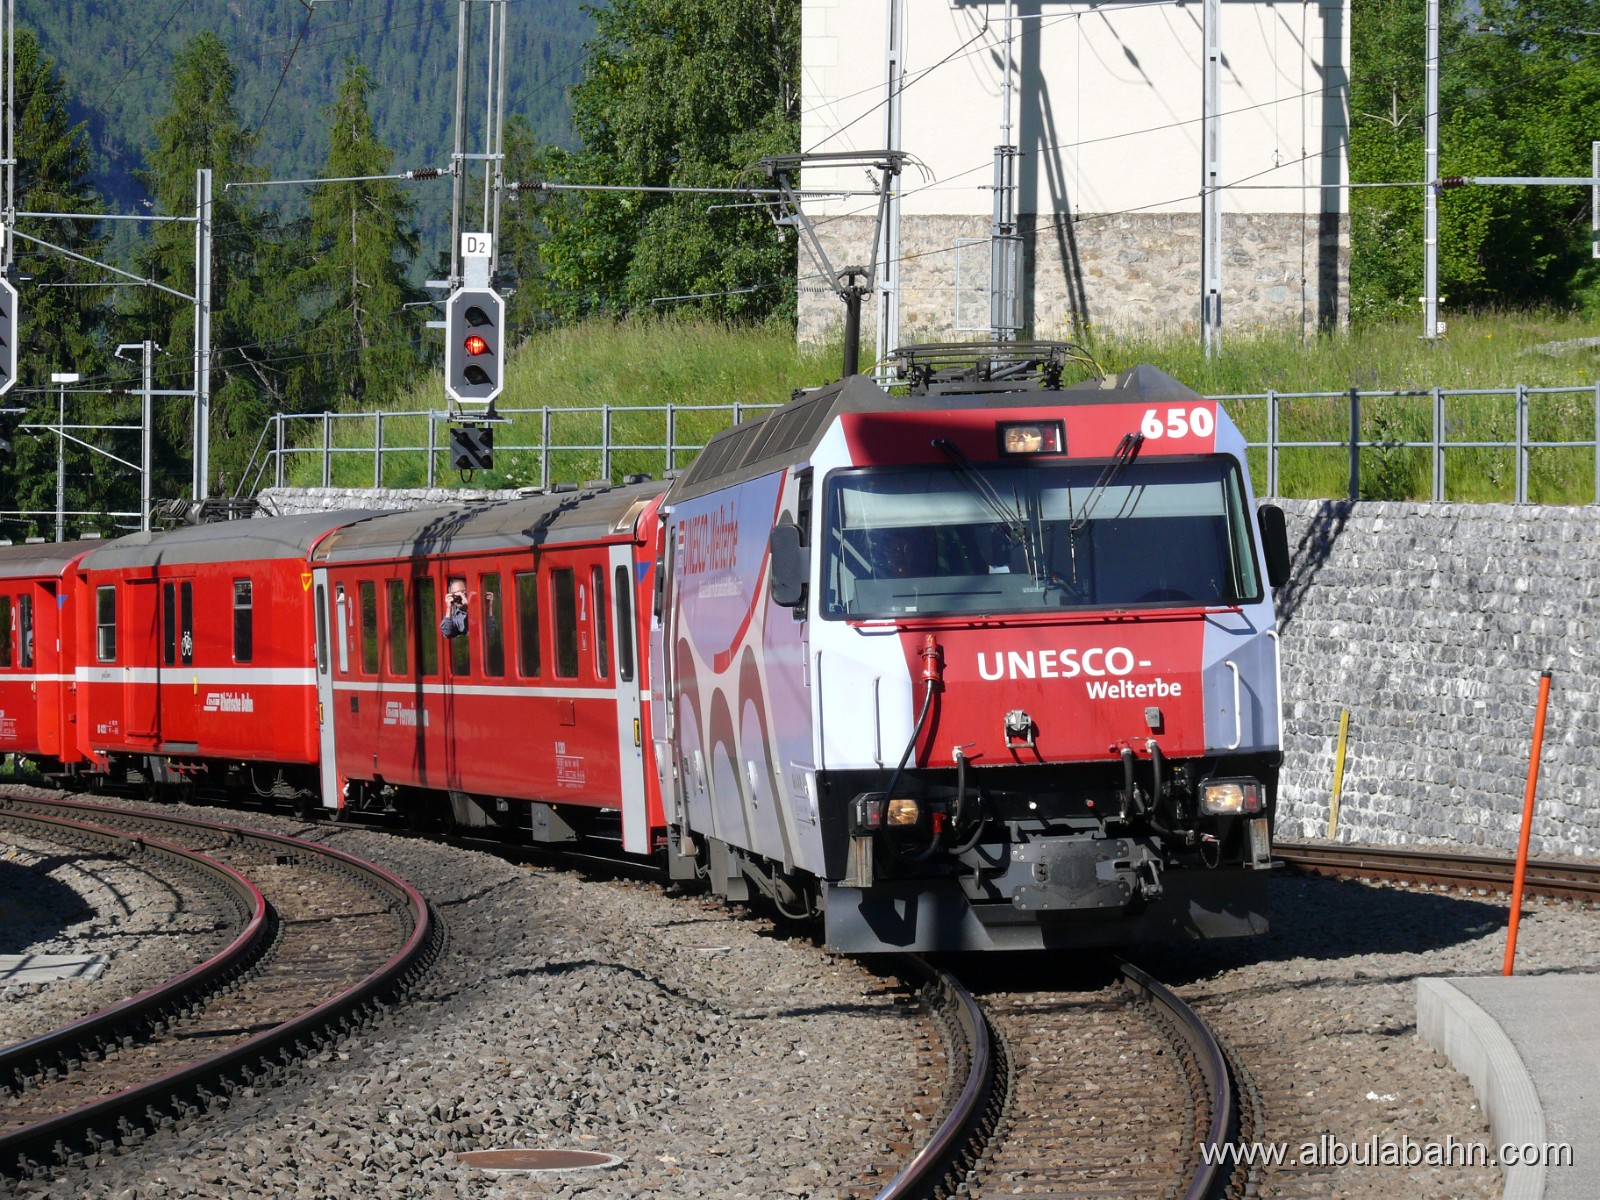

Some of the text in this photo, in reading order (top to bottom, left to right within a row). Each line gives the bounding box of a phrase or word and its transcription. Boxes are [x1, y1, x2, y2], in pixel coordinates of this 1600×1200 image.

[1141, 407, 1214, 440] 650
[11, 606, 16, 631] 2
[348, 596, 354, 627] 2
[579, 584, 587, 621] 2
[977, 647, 1152, 681] UNESCO-
[1086, 678, 1182, 700] Welterbe
